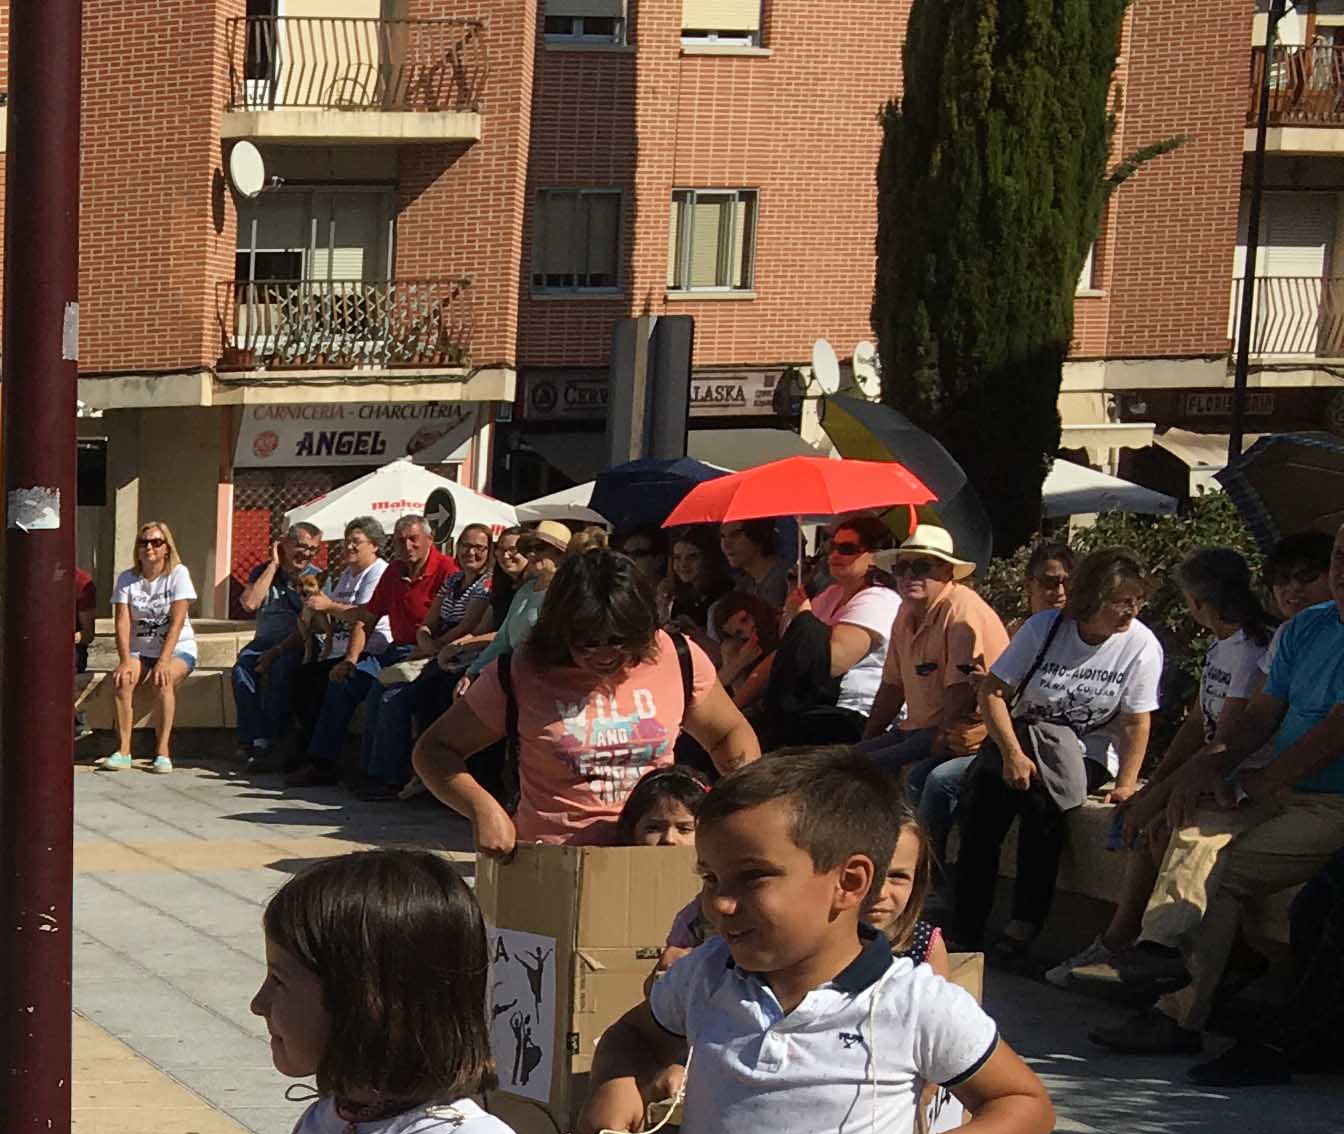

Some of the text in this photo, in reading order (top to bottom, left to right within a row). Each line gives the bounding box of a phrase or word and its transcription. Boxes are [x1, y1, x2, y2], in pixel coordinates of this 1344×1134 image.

[691, 385, 746, 402] LASKA
[296, 431, 386, 456] ANGEL
[371, 500, 425, 511] Maho
[597, 728, 630, 747] AND
